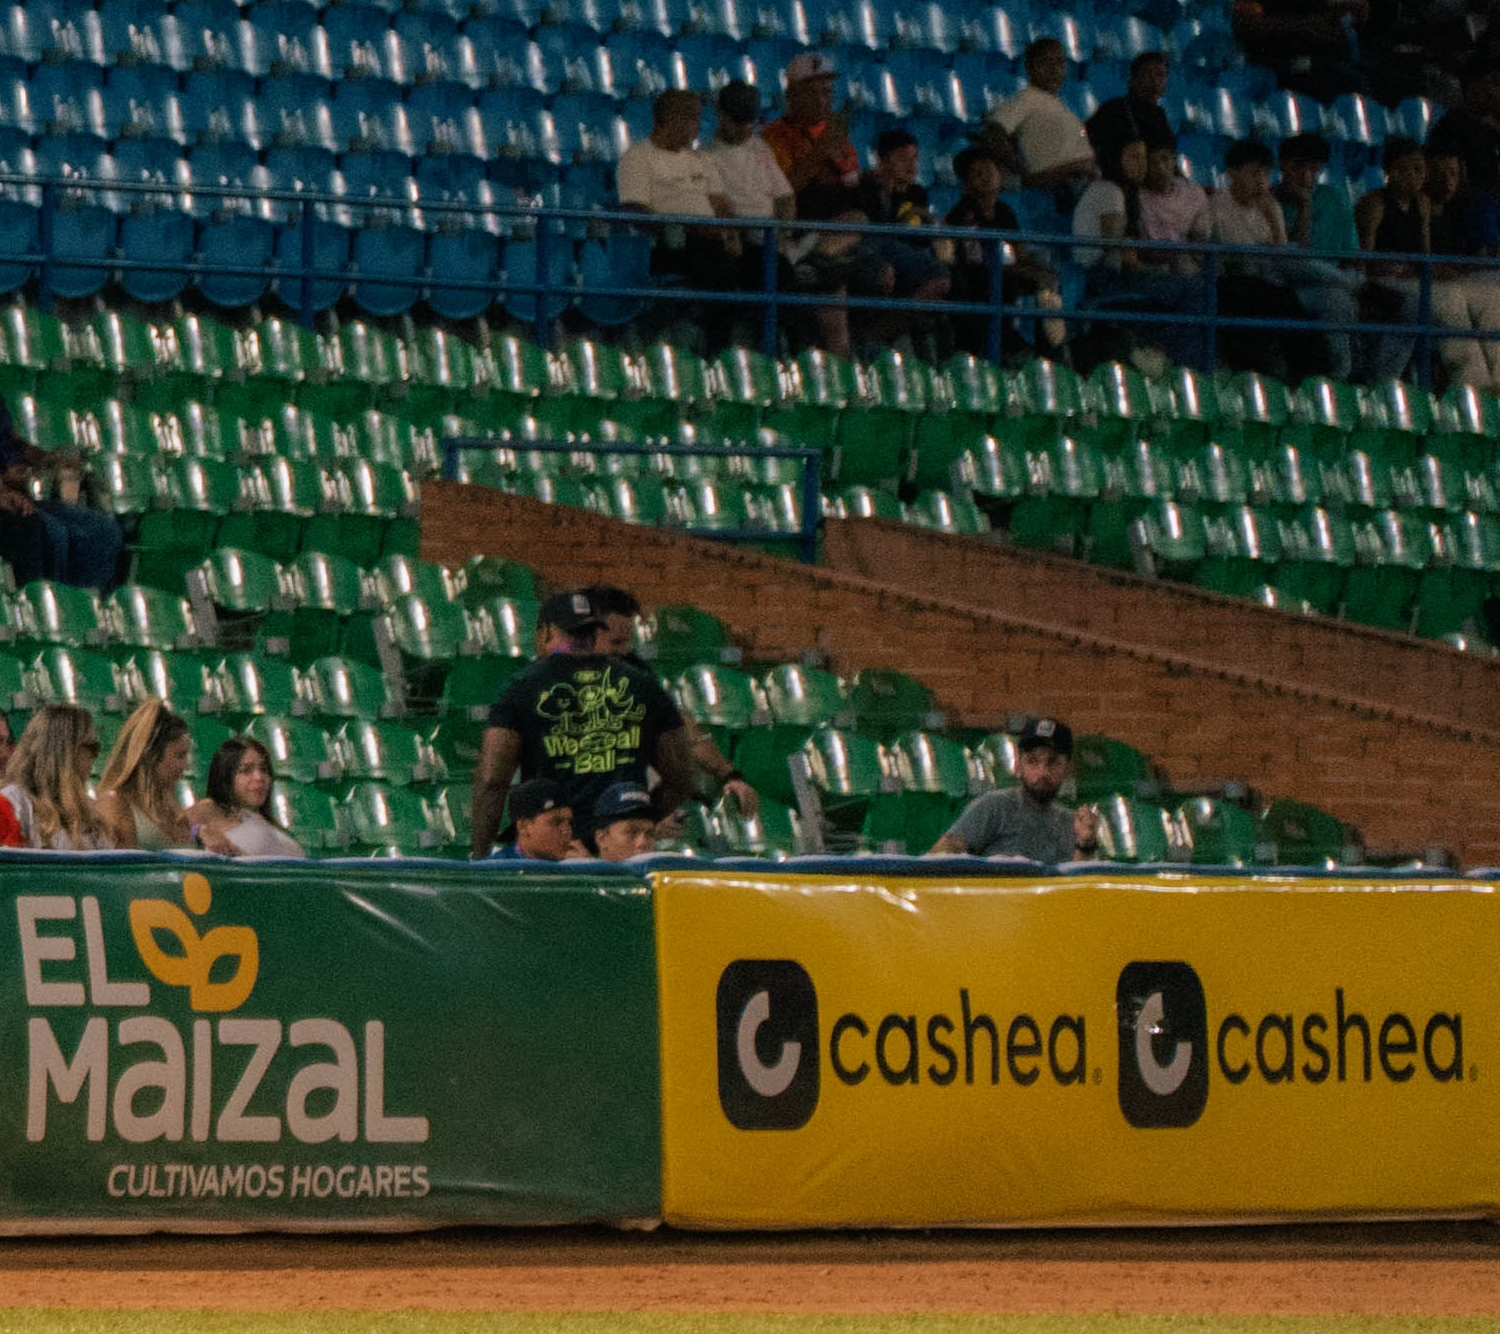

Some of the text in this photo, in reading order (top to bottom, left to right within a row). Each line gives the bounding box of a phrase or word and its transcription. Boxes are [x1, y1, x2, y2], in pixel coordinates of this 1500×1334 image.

[16, 895, 150, 1006] EL
[107, 1163, 430, 1198] CULTIVAMOS HOGARES
